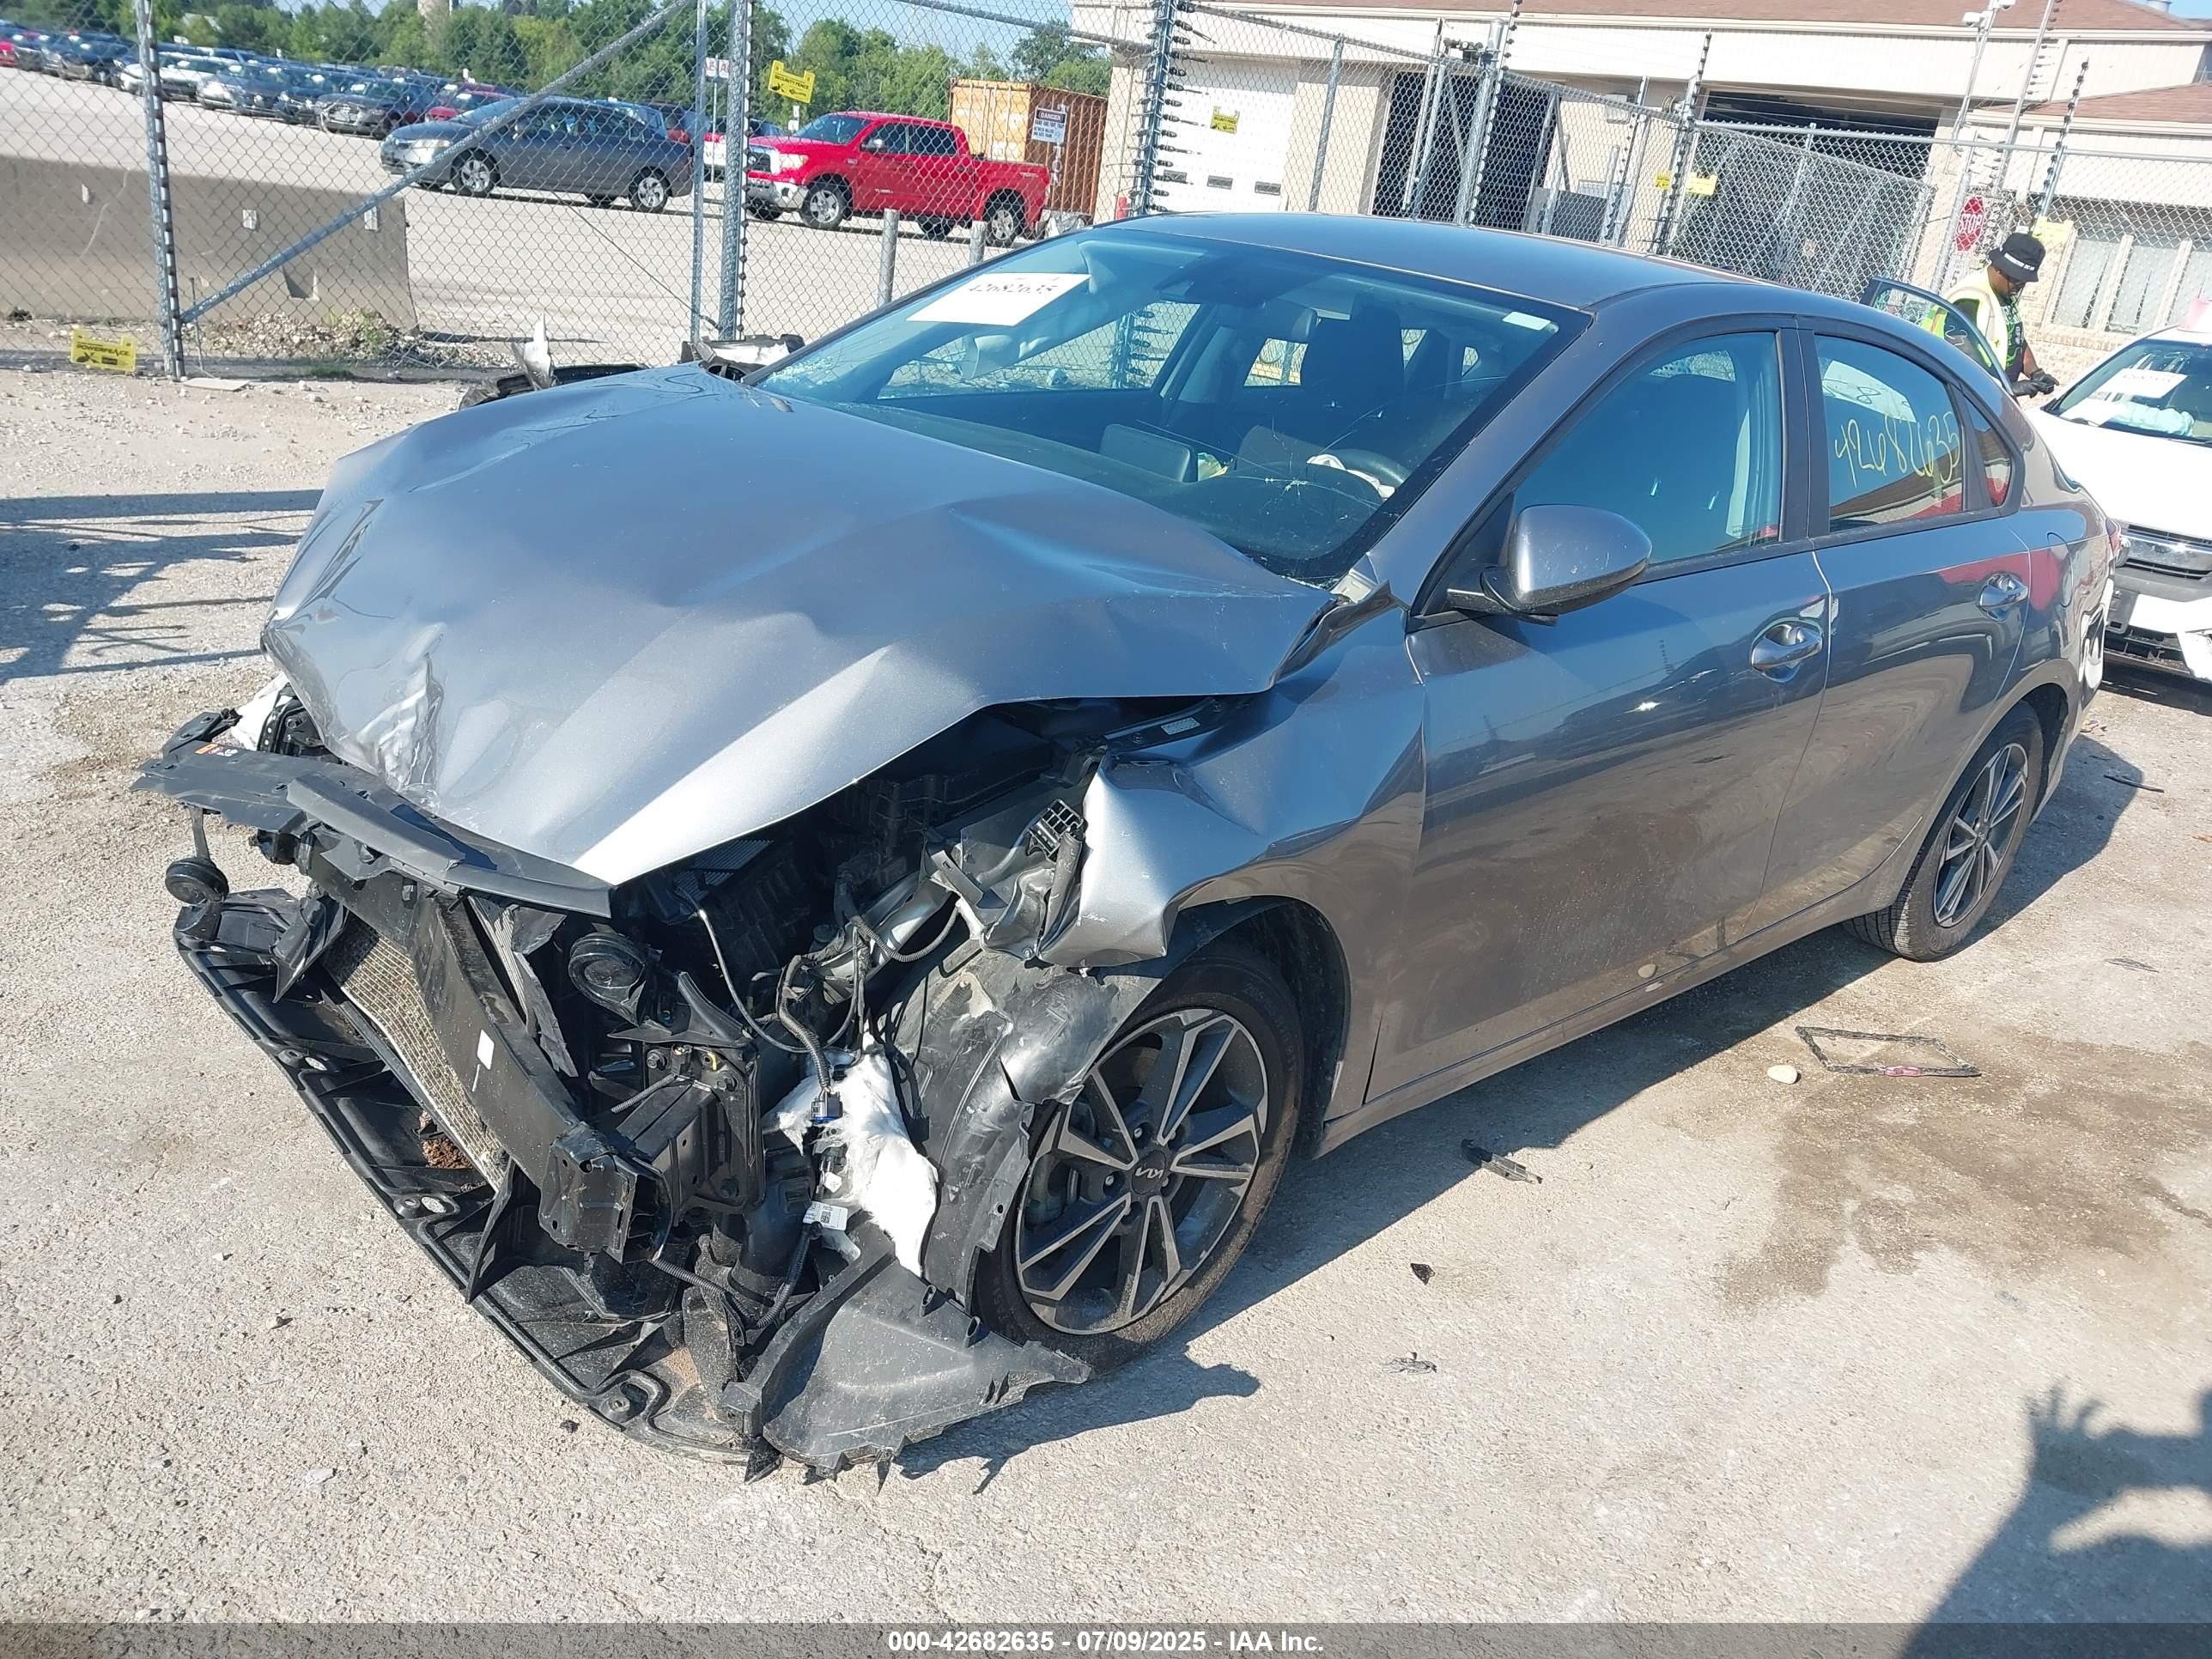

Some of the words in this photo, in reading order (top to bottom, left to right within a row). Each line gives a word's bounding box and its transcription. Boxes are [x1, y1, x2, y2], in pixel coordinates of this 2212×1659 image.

[1040, 112, 1061, 120] DANGER
[1957, 214, 1984, 234] STOP
[1834, 411, 1960, 489] 42682635
